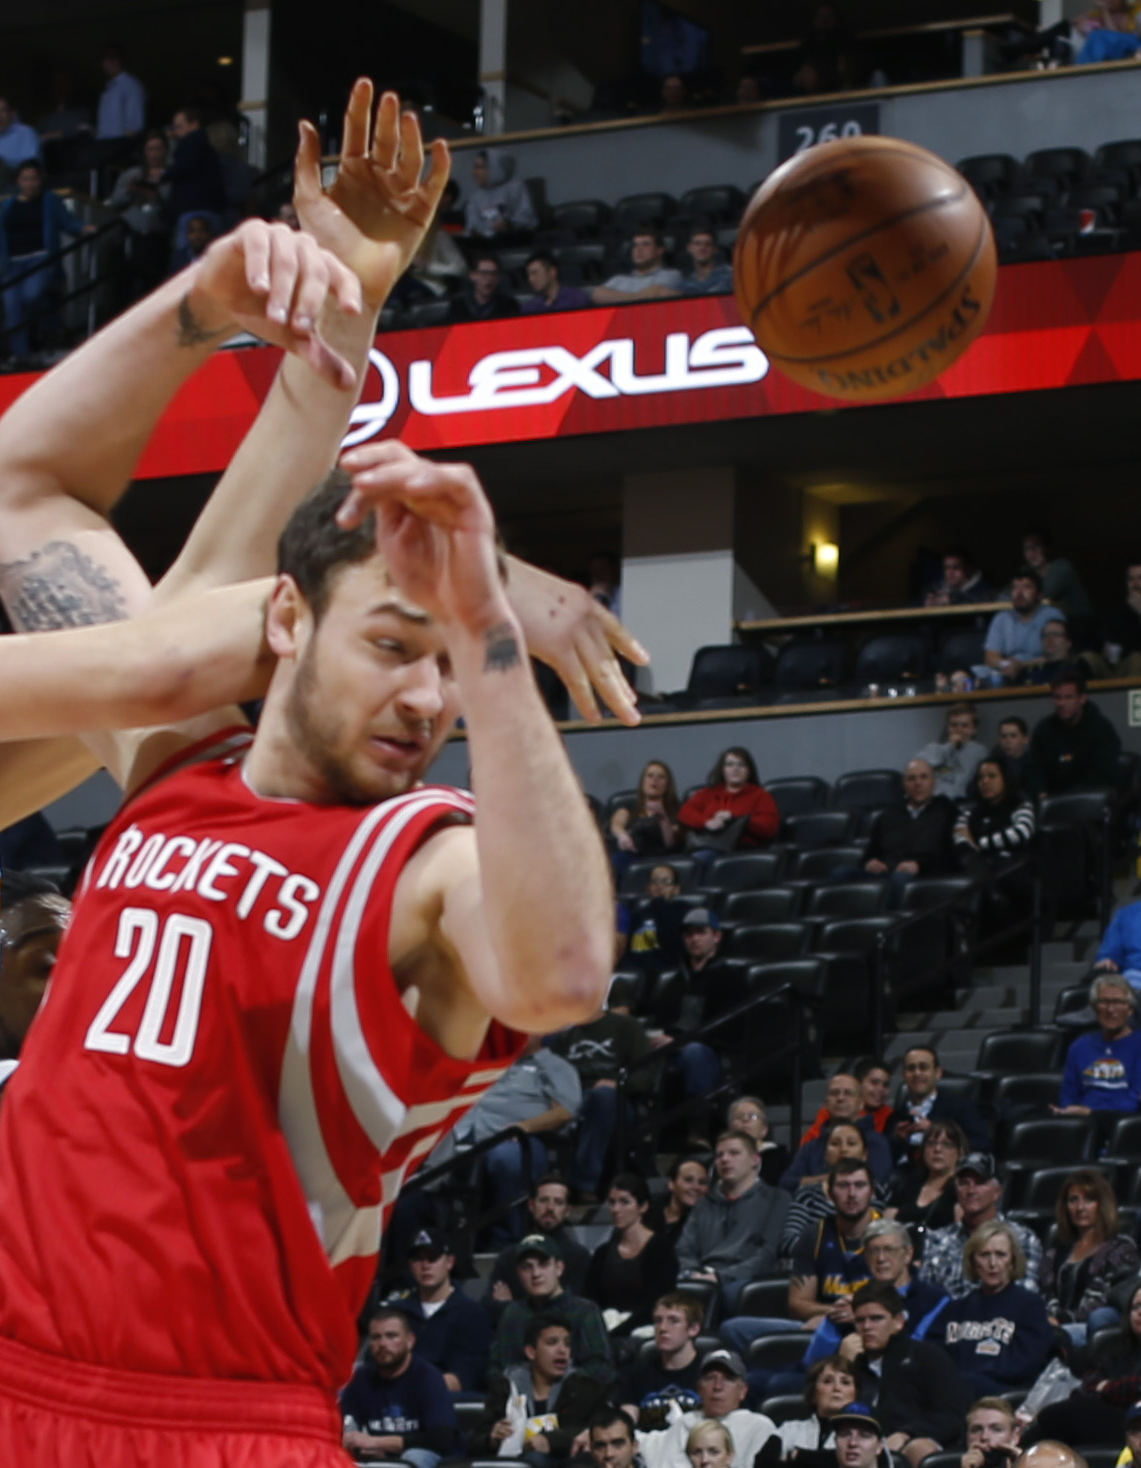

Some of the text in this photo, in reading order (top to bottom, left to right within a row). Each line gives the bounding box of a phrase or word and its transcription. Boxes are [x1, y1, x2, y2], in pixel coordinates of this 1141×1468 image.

[409, 326, 771, 416] LEXUS
[96, 822, 321, 941] ROCKETS
[83, 905, 214, 1069] 20
